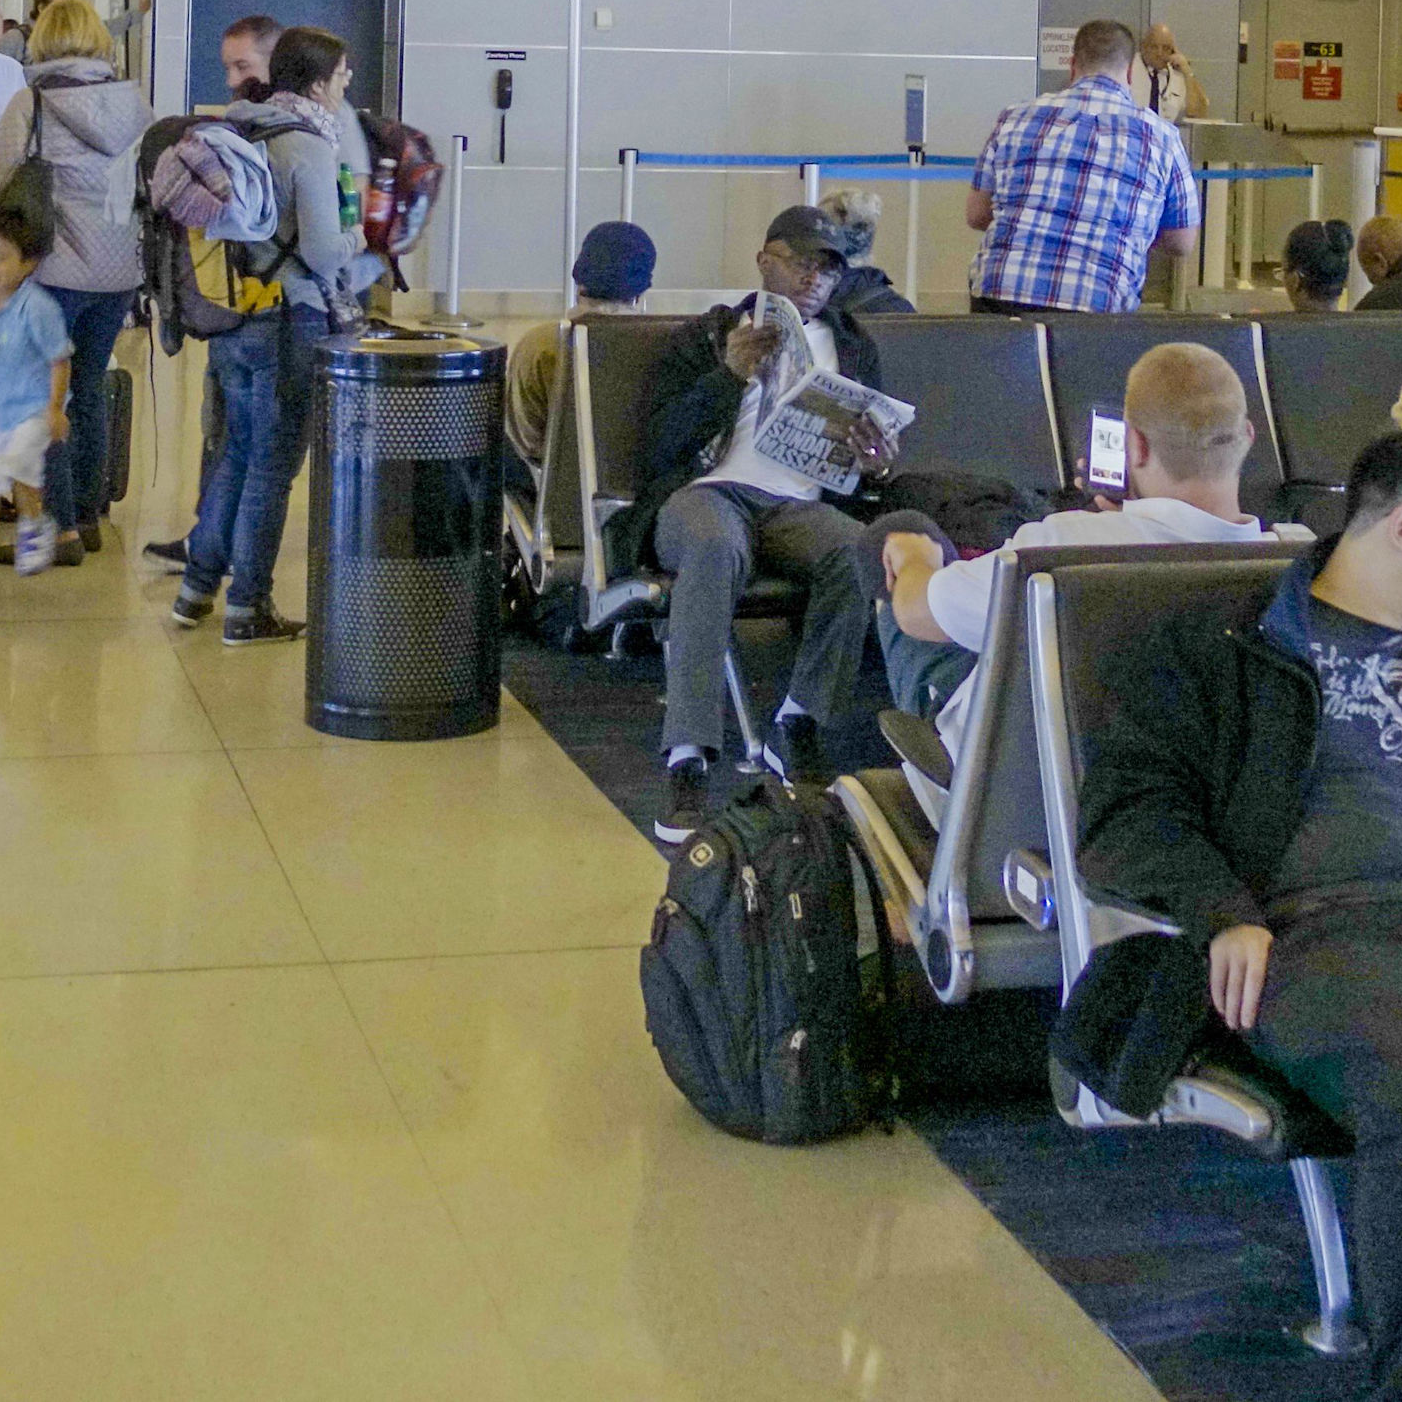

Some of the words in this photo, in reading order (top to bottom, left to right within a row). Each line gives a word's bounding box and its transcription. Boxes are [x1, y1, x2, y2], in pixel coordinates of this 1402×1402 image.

[1320, 43, 1336, 56] 63
[777, 404, 828, 437] PALM
[768, 421, 838, 460] SUNDAY
[757, 435, 850, 487] MASSACRE
